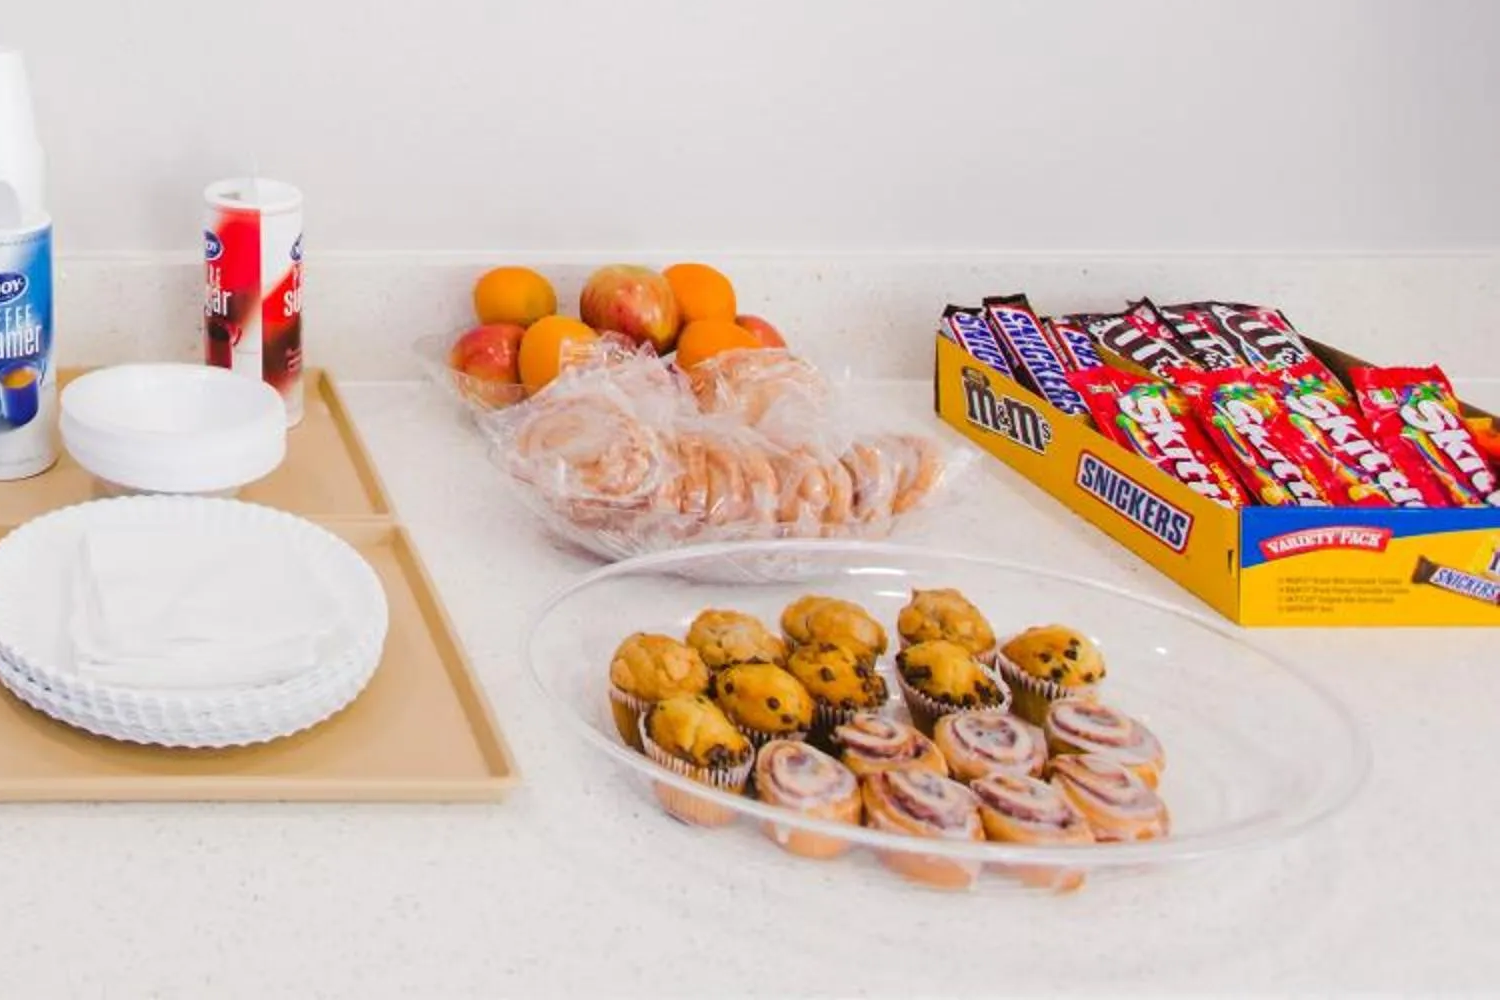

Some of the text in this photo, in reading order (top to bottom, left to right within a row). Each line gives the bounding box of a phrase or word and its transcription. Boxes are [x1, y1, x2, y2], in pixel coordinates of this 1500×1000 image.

[1080, 457, 1187, 547] SNICKERS
[1267, 530, 1382, 554] VARIETY PACK
[1434, 568, 1496, 598] SNICKERS
